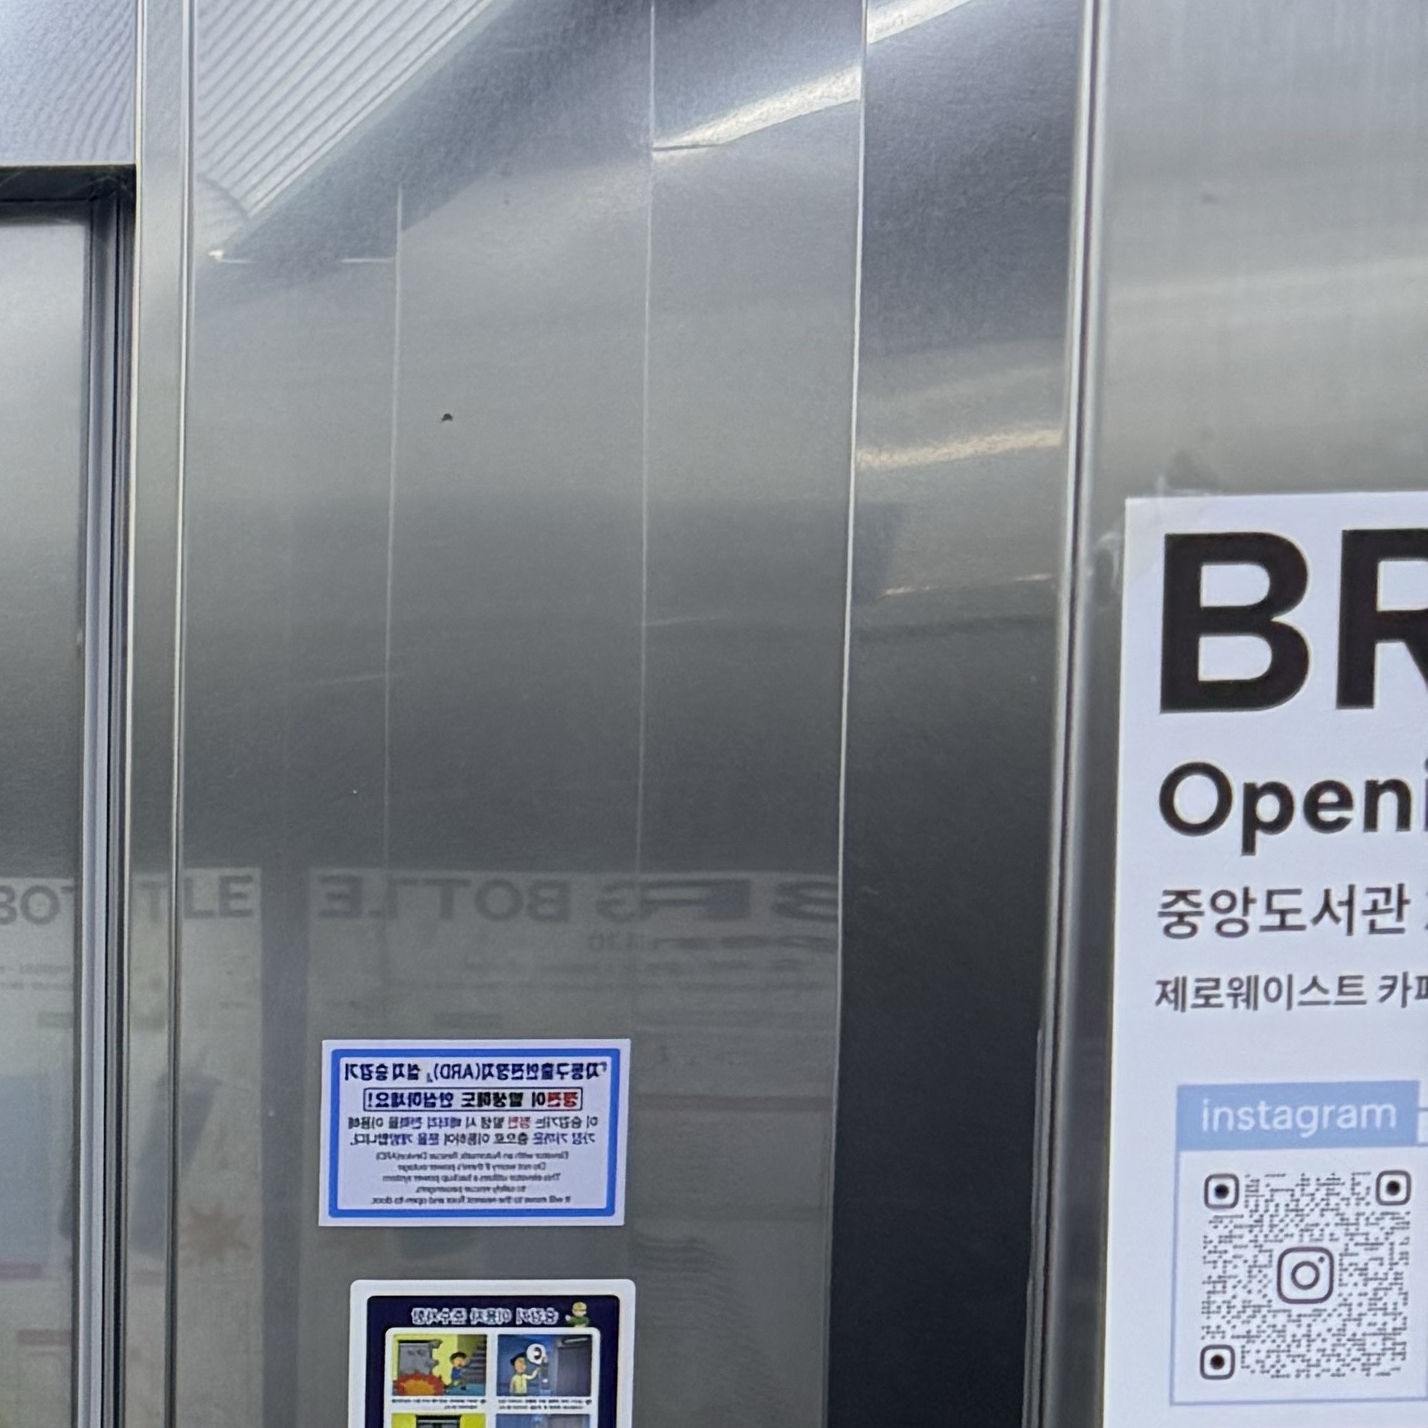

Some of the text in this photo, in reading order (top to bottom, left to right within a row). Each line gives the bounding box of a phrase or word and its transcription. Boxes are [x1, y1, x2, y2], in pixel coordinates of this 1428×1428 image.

[1157, 883, 1411, 940] 중앙도서관
[1154, 973, 1367, 1013] 제로웨이스트
[1202, 1097, 1396, 1139] instagram
